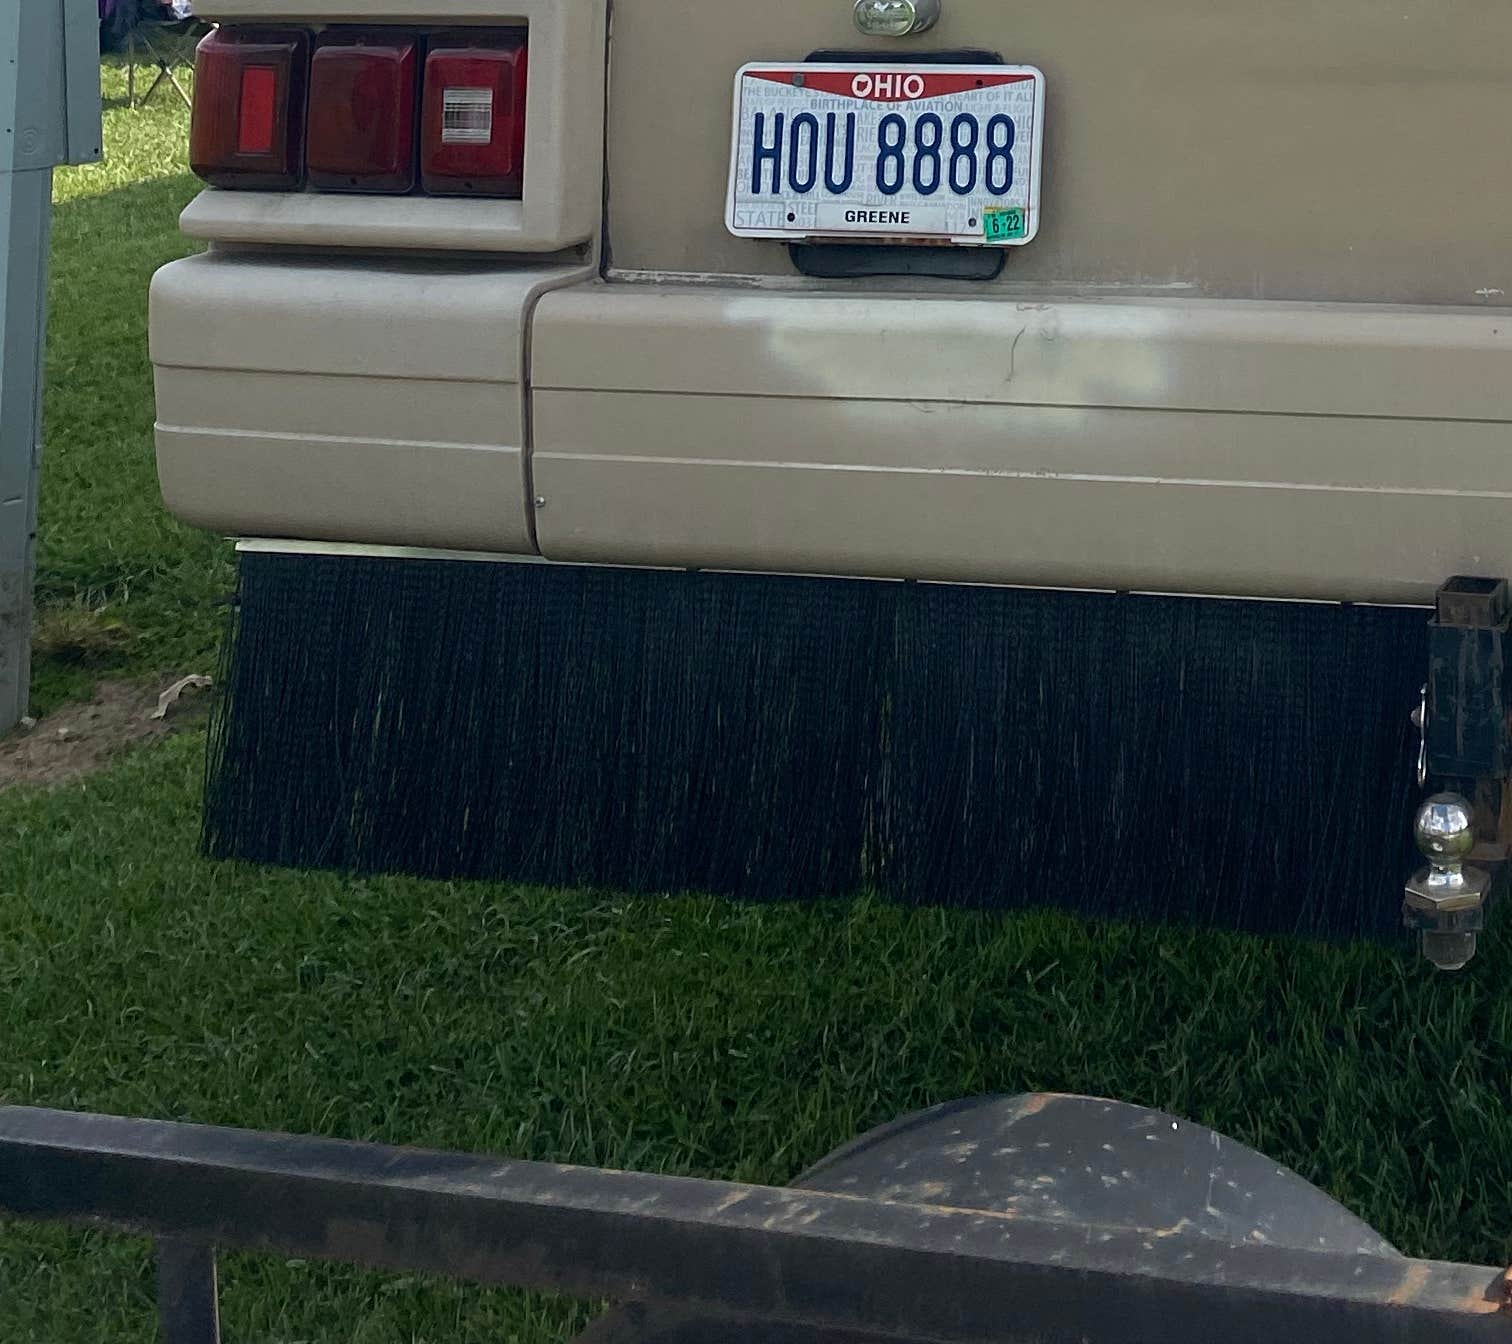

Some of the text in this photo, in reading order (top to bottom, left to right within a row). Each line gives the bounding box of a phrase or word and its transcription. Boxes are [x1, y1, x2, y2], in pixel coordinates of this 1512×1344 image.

[851, 73, 925, 99] OHIO
[810, 98, 885, 111] BIRTHPLACE
[905, 101, 963, 112] AVIATION
[751, 111, 1016, 196] HOU 8888
[845, 210, 911, 224] GREENE
[1006, 214, 1020, 232] 22
